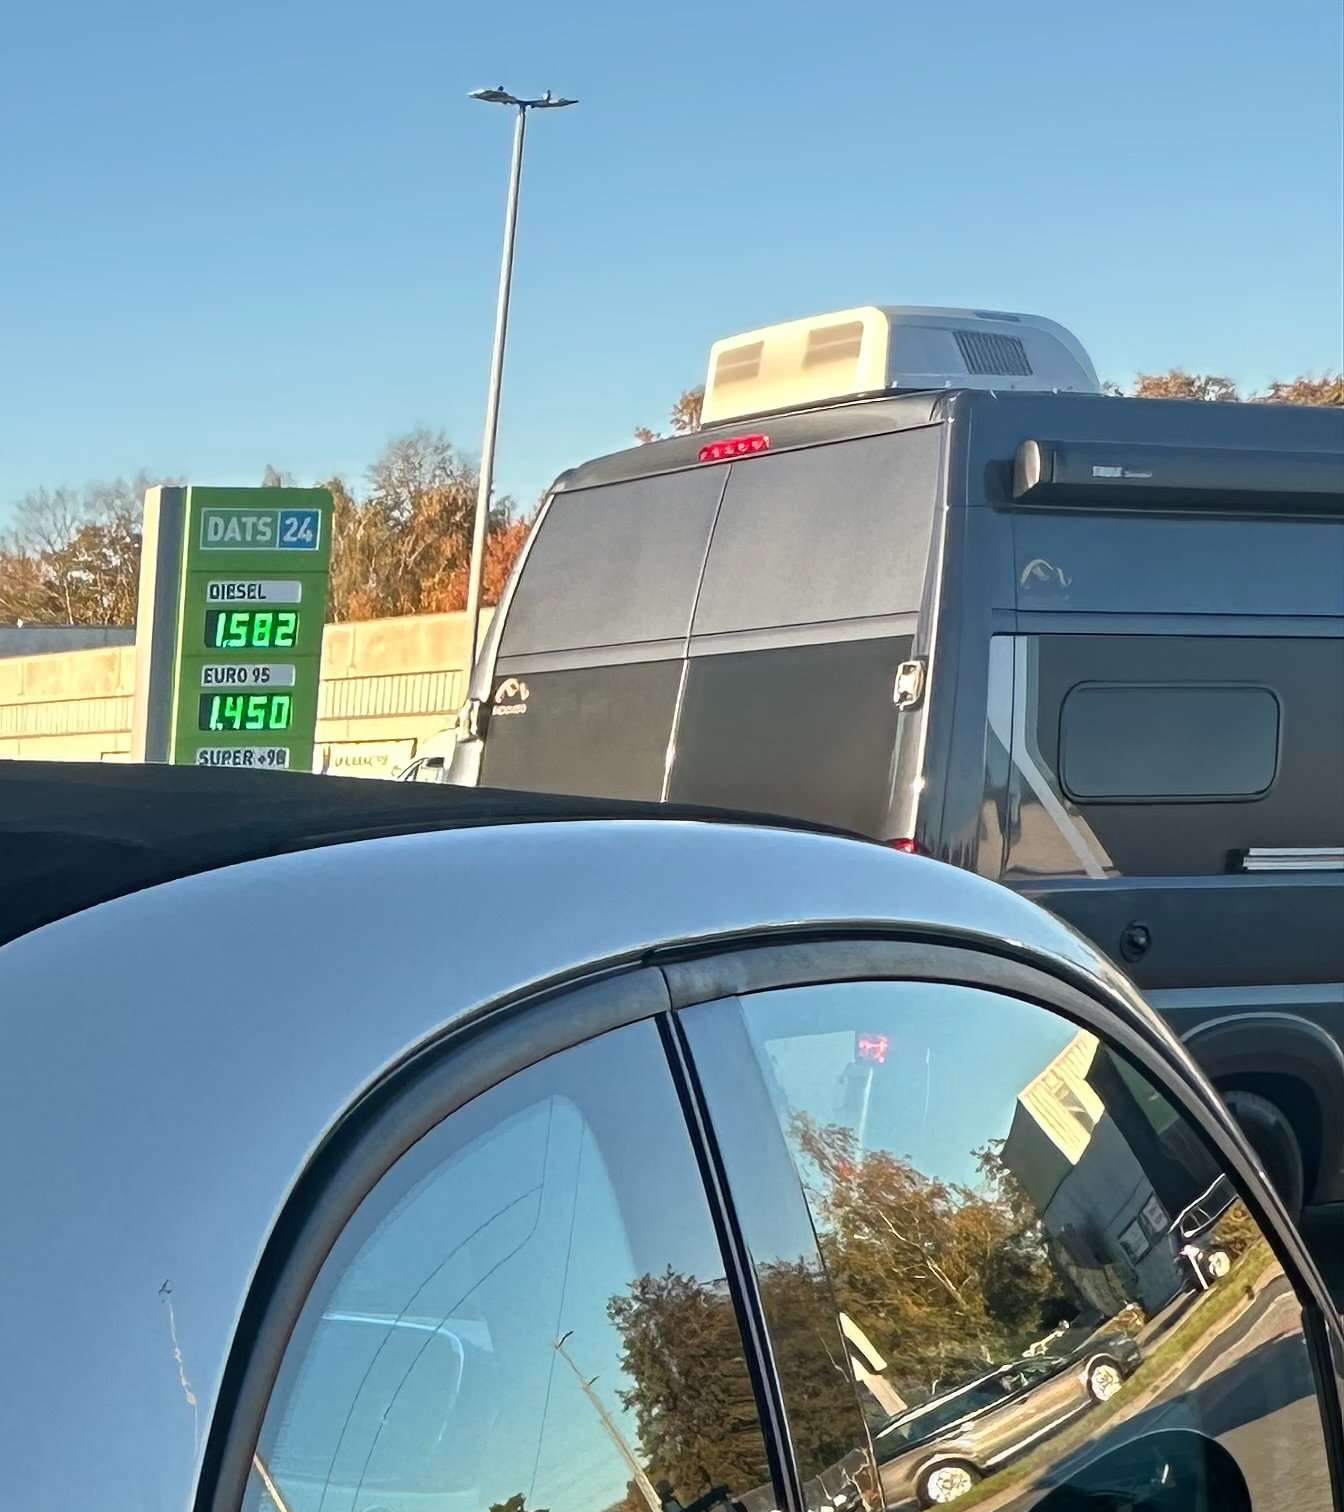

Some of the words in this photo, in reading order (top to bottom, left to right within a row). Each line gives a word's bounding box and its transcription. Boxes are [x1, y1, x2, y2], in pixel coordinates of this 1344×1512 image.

[207, 516, 273, 541] DATS
[282, 517, 313, 542] 24
[209, 583, 267, 600] DIESEL
[204, 667, 248, 684] EURO
[252, 667, 271, 683] 95
[198, 749, 253, 766] SUPER
